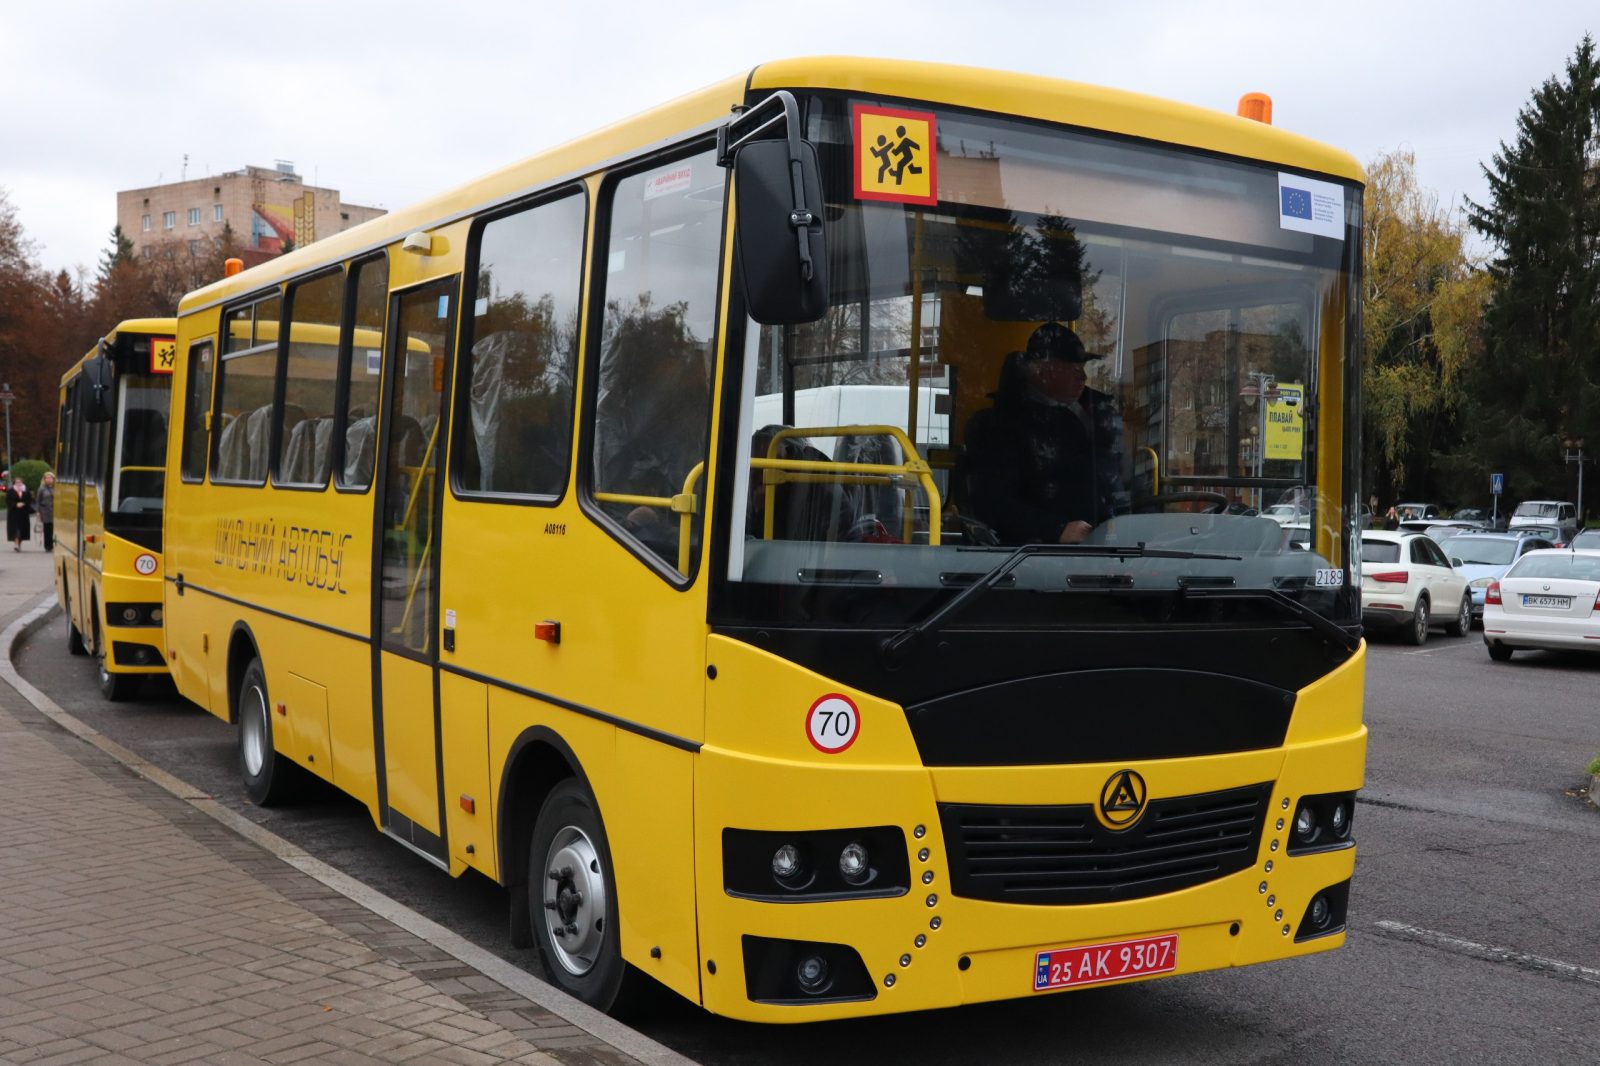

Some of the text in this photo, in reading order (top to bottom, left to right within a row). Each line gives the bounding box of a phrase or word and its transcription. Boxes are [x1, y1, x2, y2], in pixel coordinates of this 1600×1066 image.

[214, 517, 352, 594] ШКІЛЬНИЙ АВТОБУС
[140, 559, 154, 570] 70
[1316, 570, 1343, 585] 2189
[1528, 597, 1569, 606] BK 6573 HM
[818, 711, 850, 736] 70
[1051, 940, 1171, 983] 25 AK 9307
[1037, 974, 1048, 984] UA
